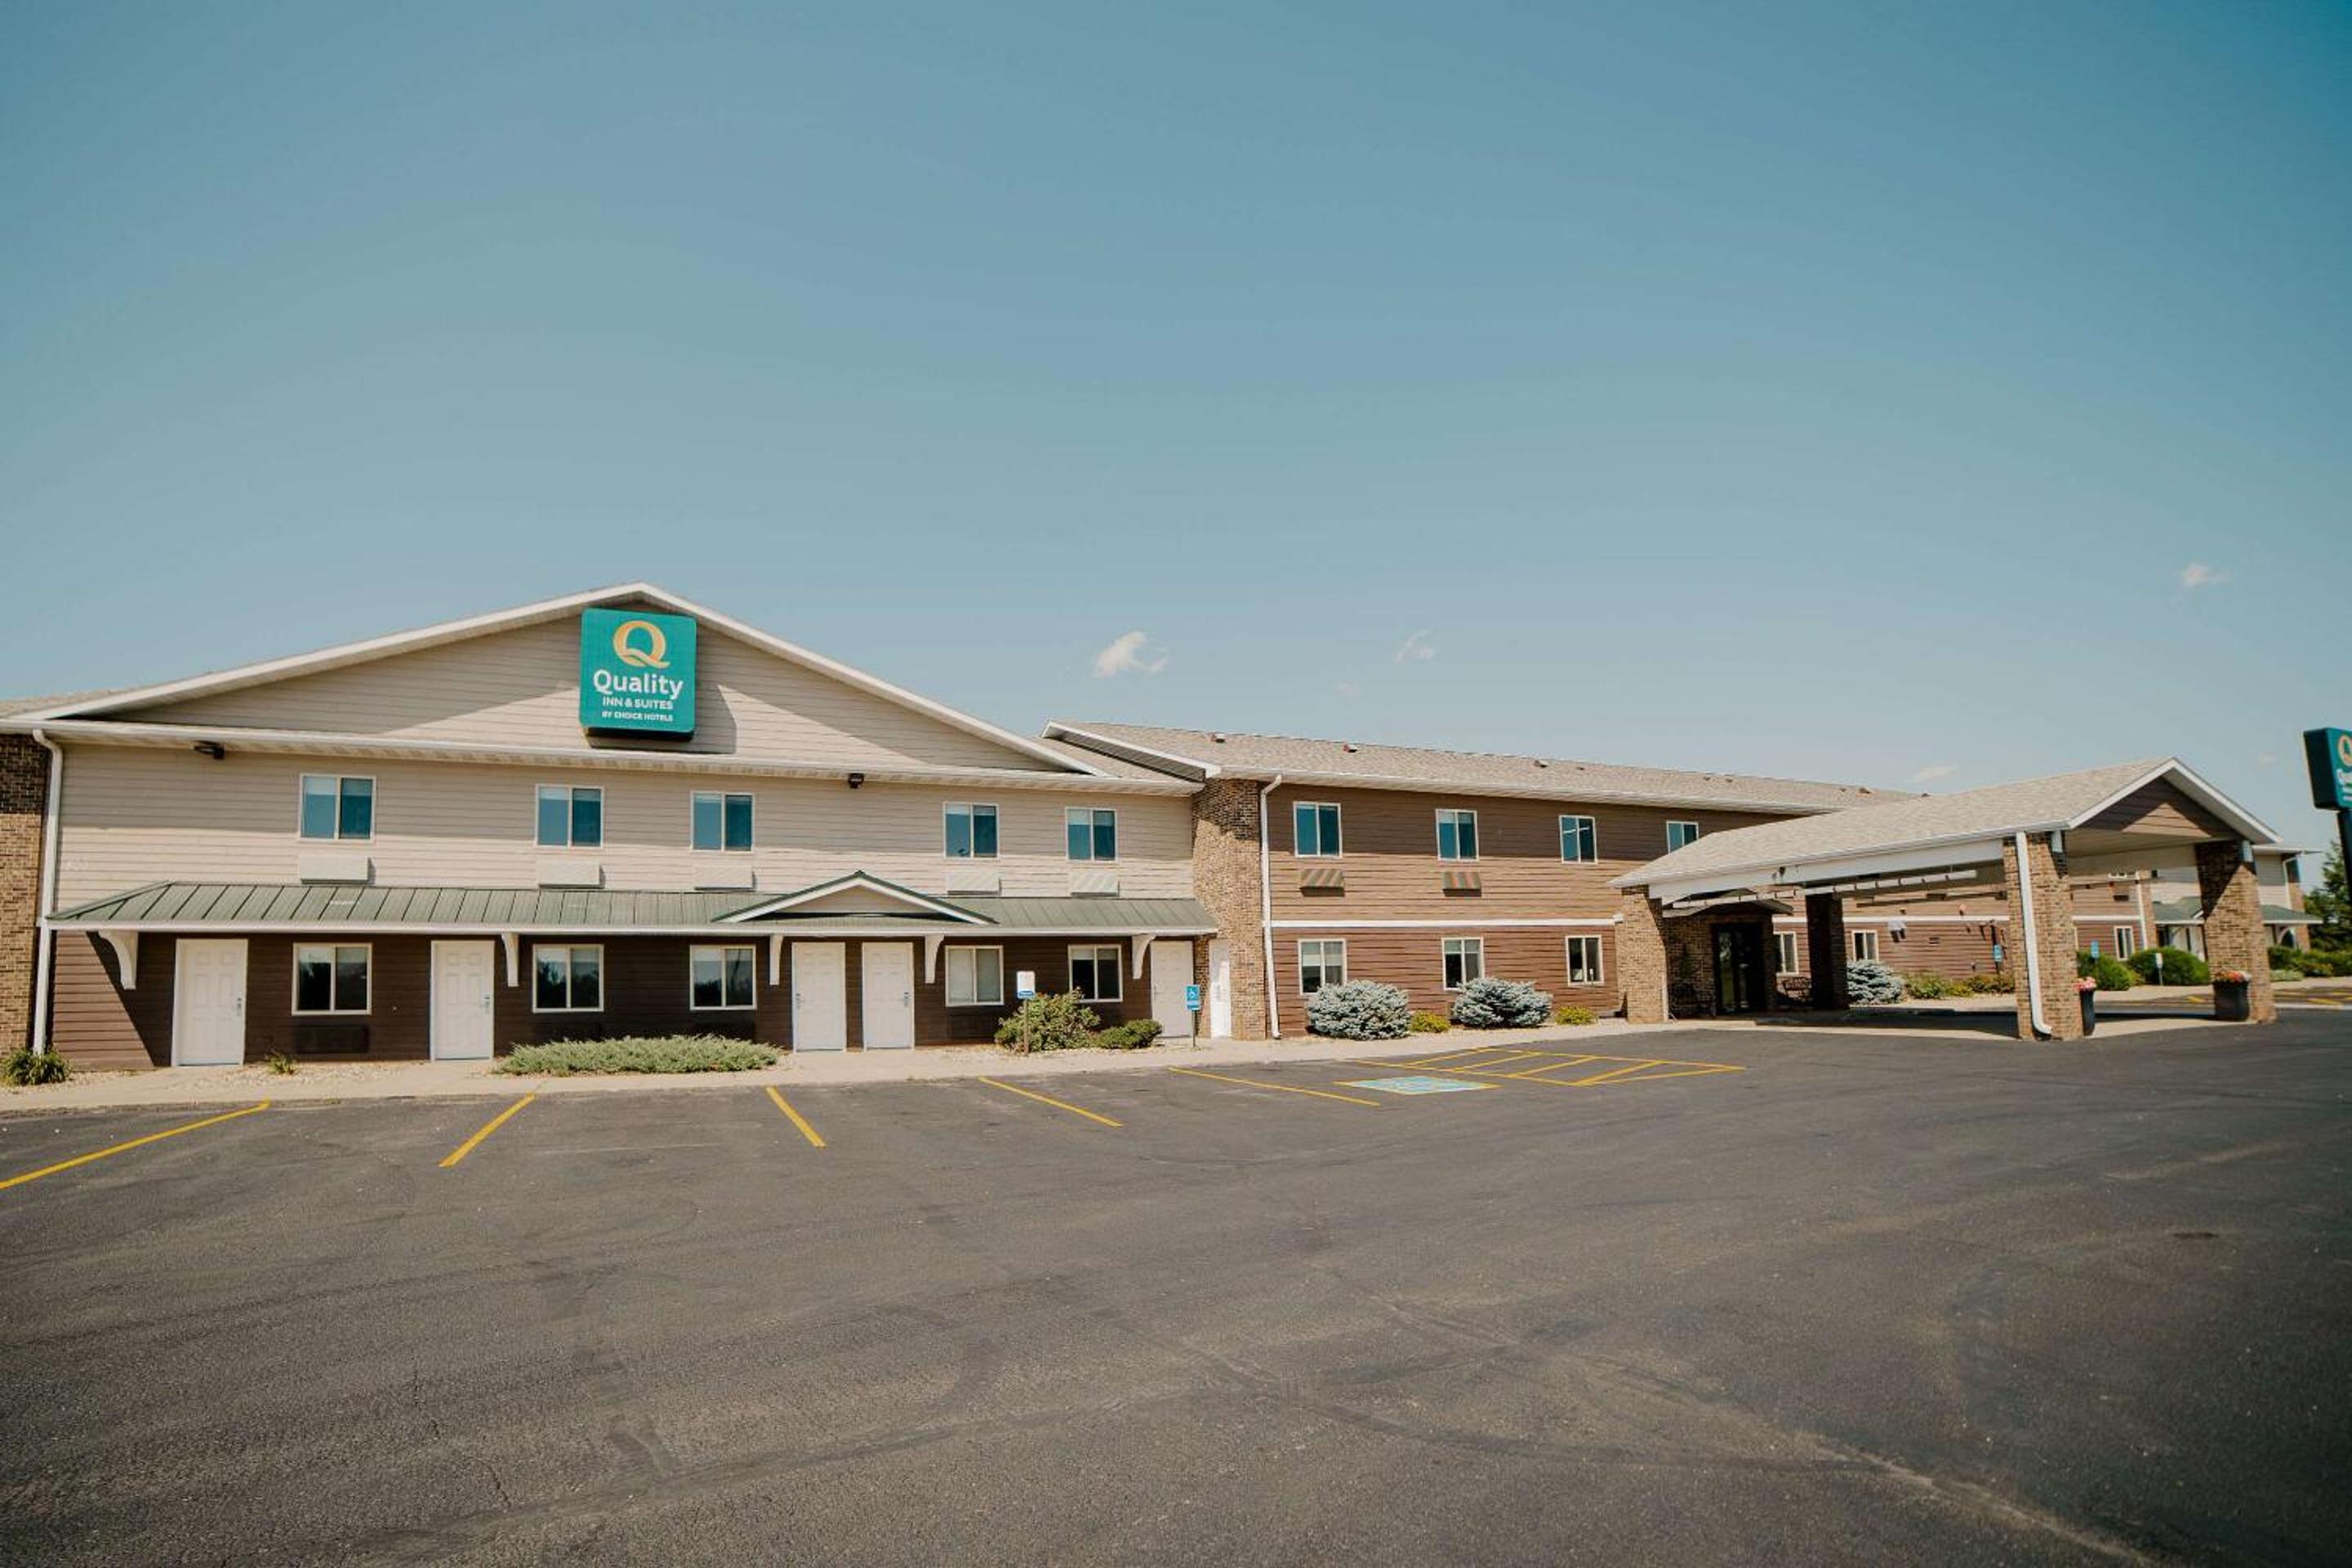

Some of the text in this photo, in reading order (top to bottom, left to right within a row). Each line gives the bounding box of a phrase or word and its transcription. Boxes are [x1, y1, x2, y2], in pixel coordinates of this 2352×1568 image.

[613, 620, 670, 669] Q
[593, 669, 684, 700] Quality
[603, 696, 673, 710] INN & SUITES
[614, 711, 643, 719] CHOICE
[644, 713, 673, 722] HOTELS
